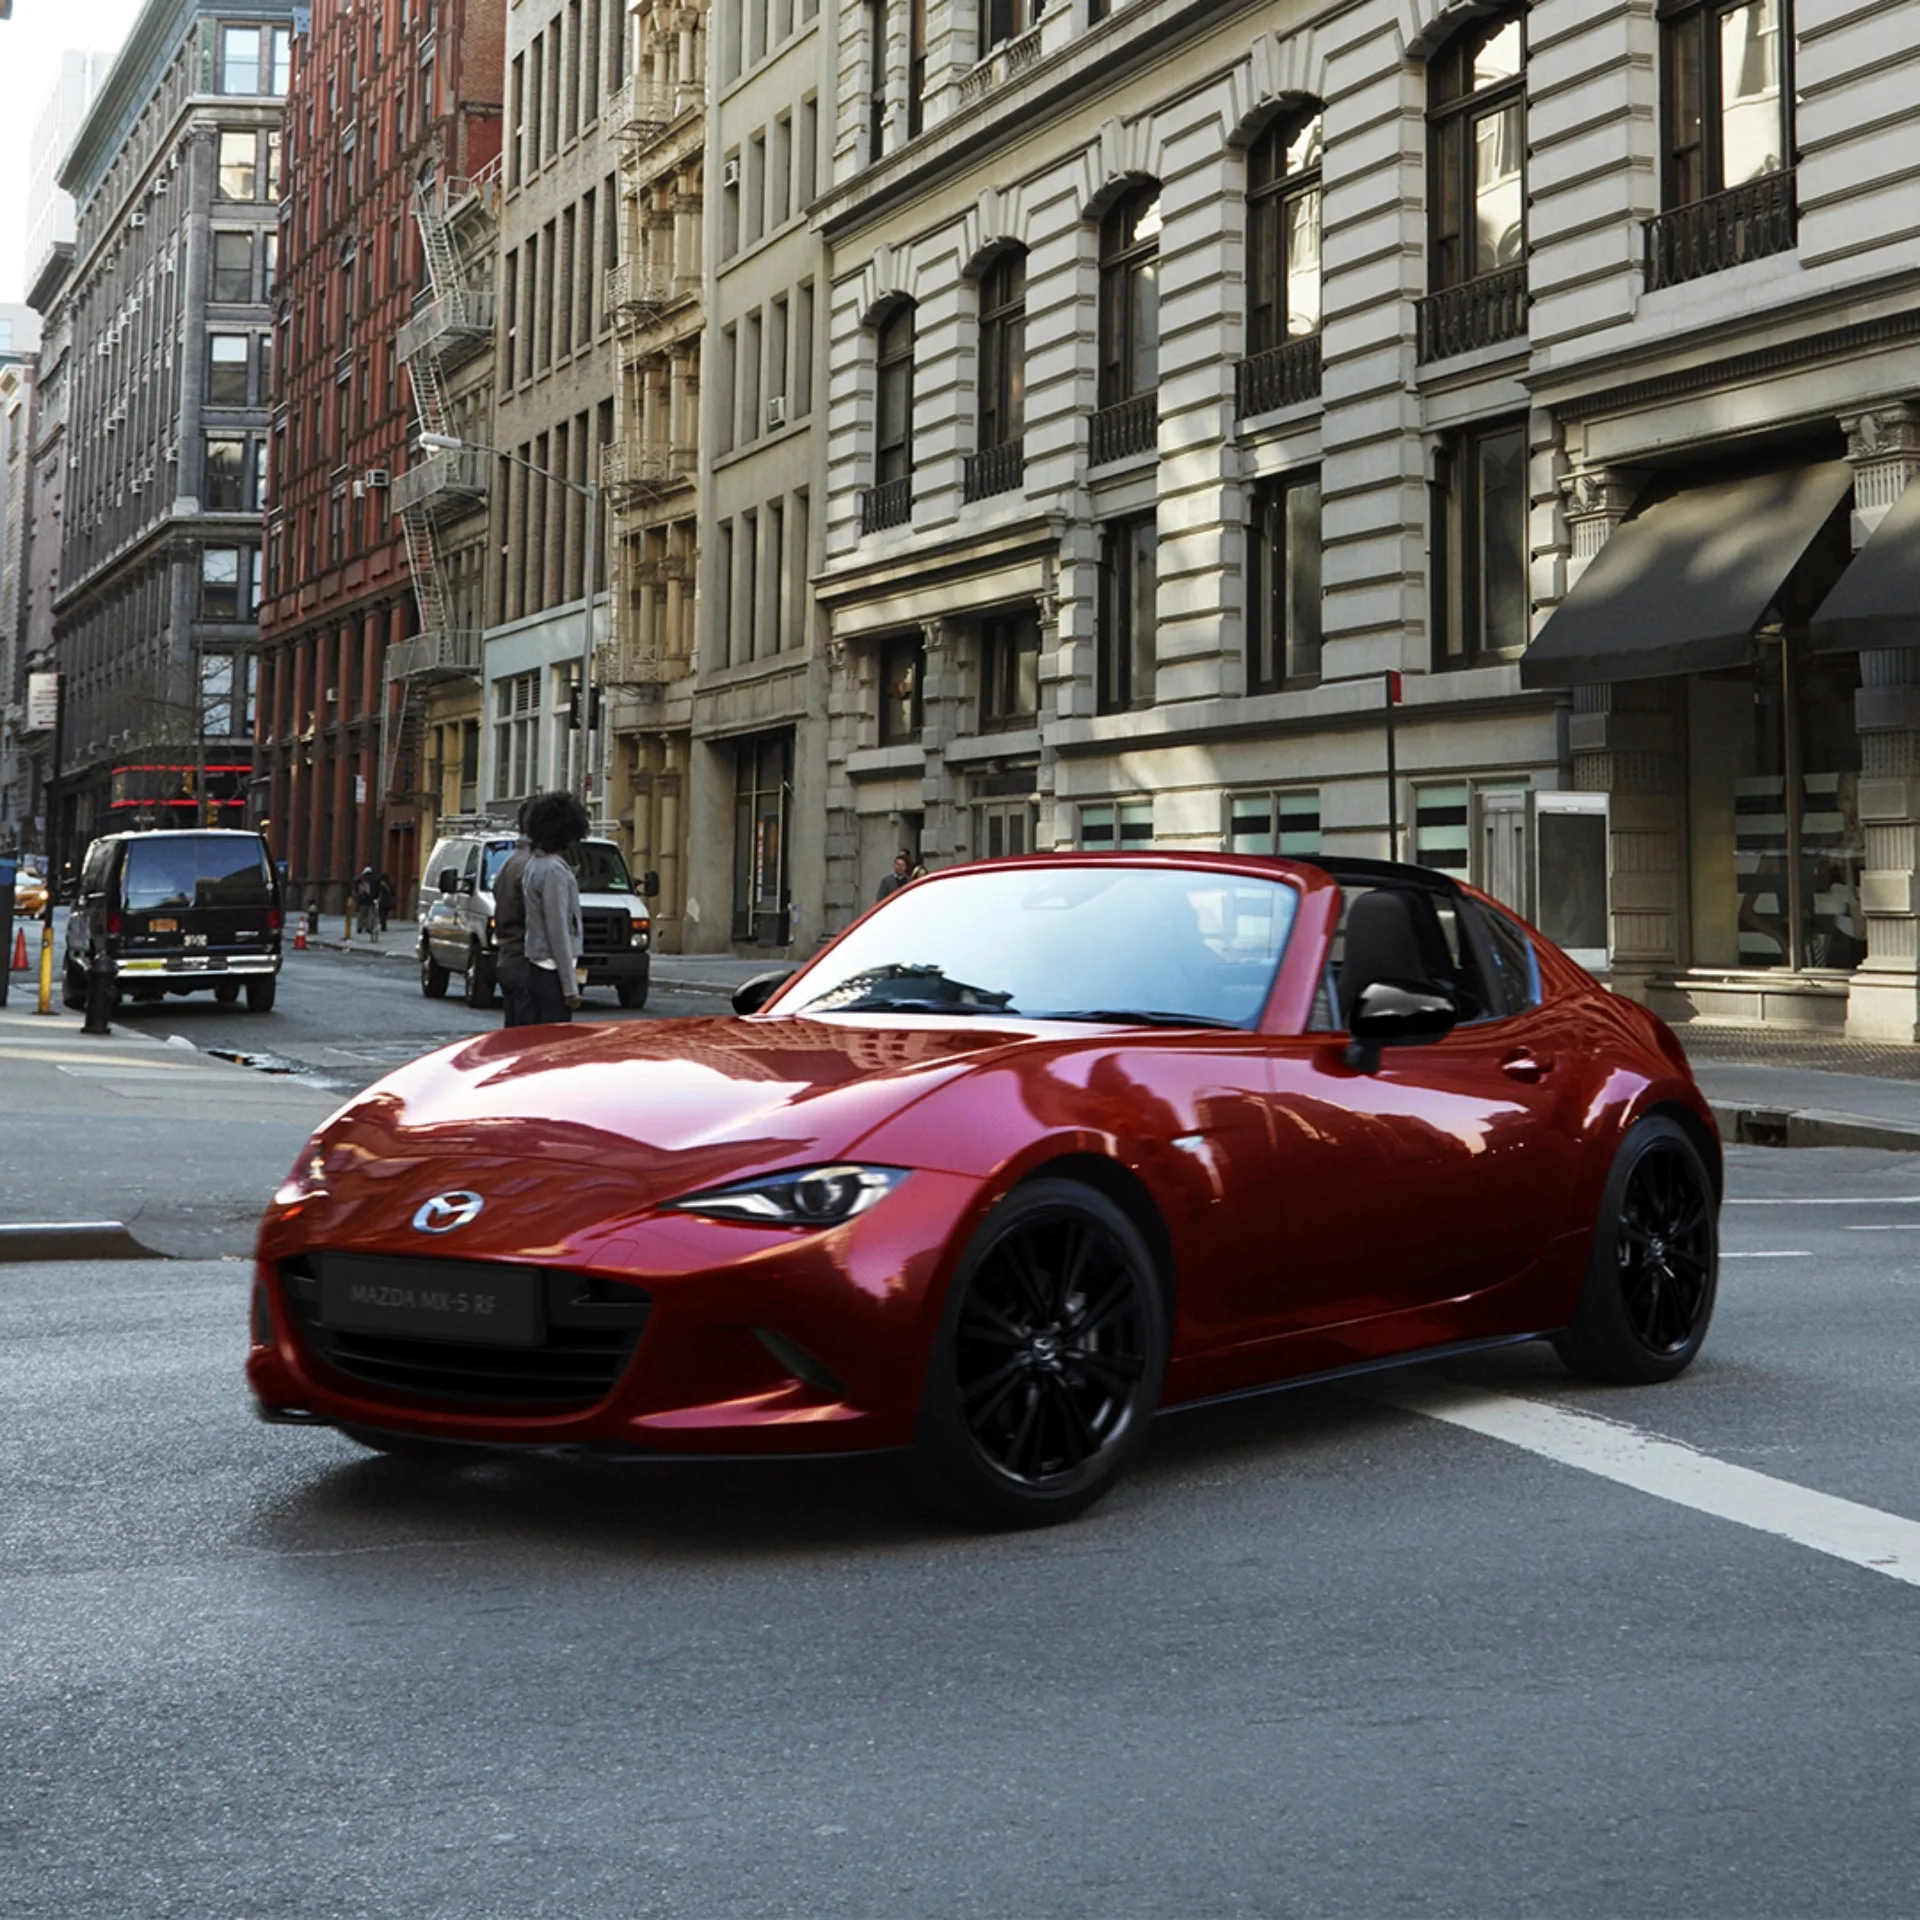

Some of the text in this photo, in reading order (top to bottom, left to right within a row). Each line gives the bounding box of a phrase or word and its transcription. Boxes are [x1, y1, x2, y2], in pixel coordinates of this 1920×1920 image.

[350, 1284, 497, 1315] MAZDA MX-5 RF
